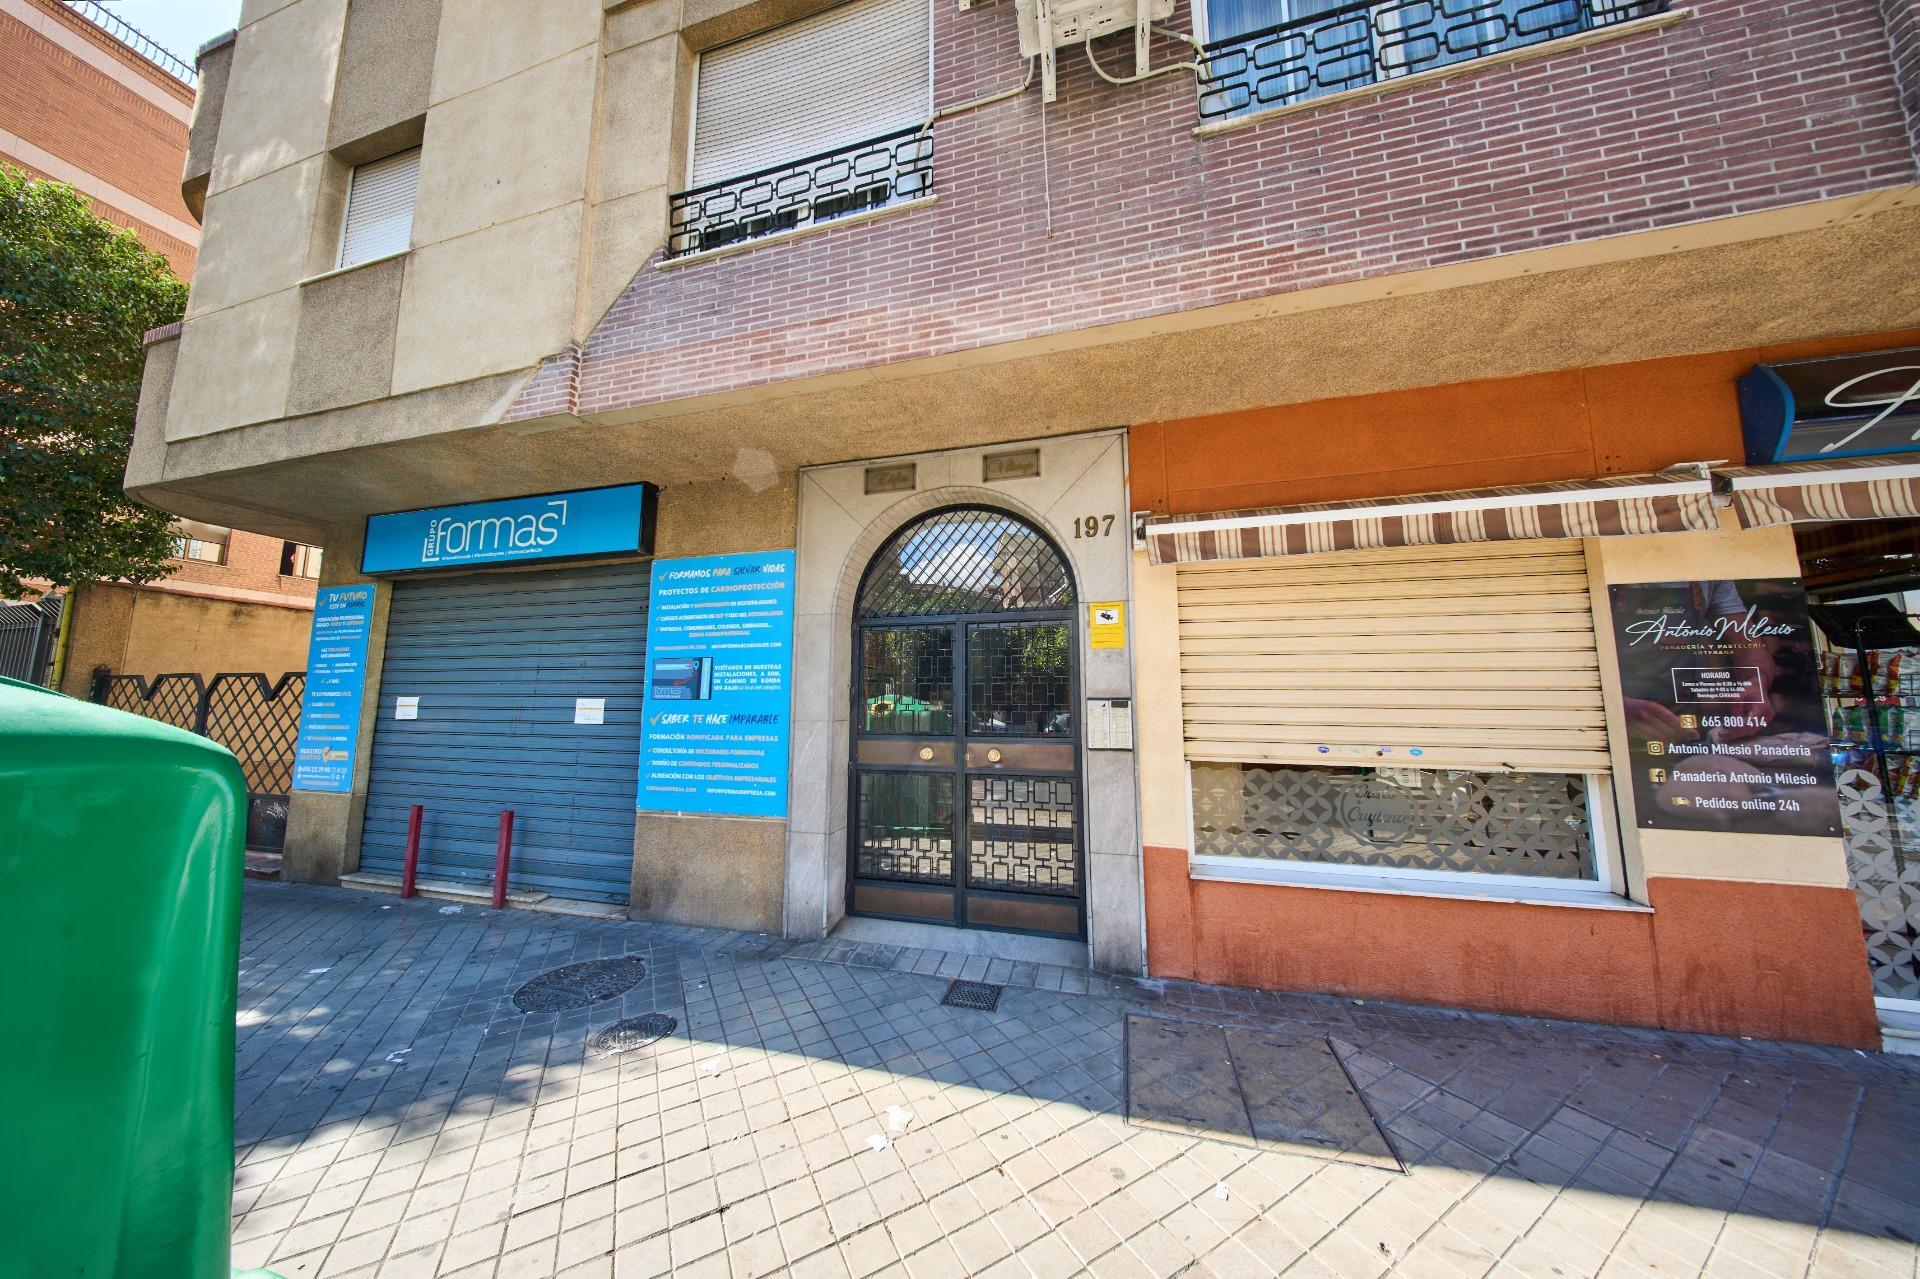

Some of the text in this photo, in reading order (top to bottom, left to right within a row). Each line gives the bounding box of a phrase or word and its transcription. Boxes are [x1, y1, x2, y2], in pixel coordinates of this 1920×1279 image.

[1074, 514, 1116, 538] 197
[427, 519, 437, 556] GRUPO
[435, 512, 559, 555] formas
[669, 563, 786, 580] FORMAMOS PARA SALVAR VIDAS
[659, 581, 785, 596] PROYECTOS DE CARDIOPROTECCIÓN
[329, 591, 367, 602] TU FUTURO
[1625, 604, 1795, 646] Antonio Milesio
[654, 686, 682, 695] formas
[661, 713, 781, 725] SABER TE HACE IMPARABLE
[1701, 716, 1767, 728] 665 800 414
[649, 732, 685, 740] FORMACIÓN
[744, 734, 779, 742] EMPRESAS
[652, 746, 687, 754] CONSULTORÍA
[1668, 743, 1811, 757] Antonio Milesio Panaderia
[652, 759, 671, 767] DISEÑO
[651, 772, 681, 780] ALINEACIÓN
[1673, 770, 1817, 785] Panaderia Antonio Milesio
[1695, 797, 1800, 811] Pedidos online 24h
